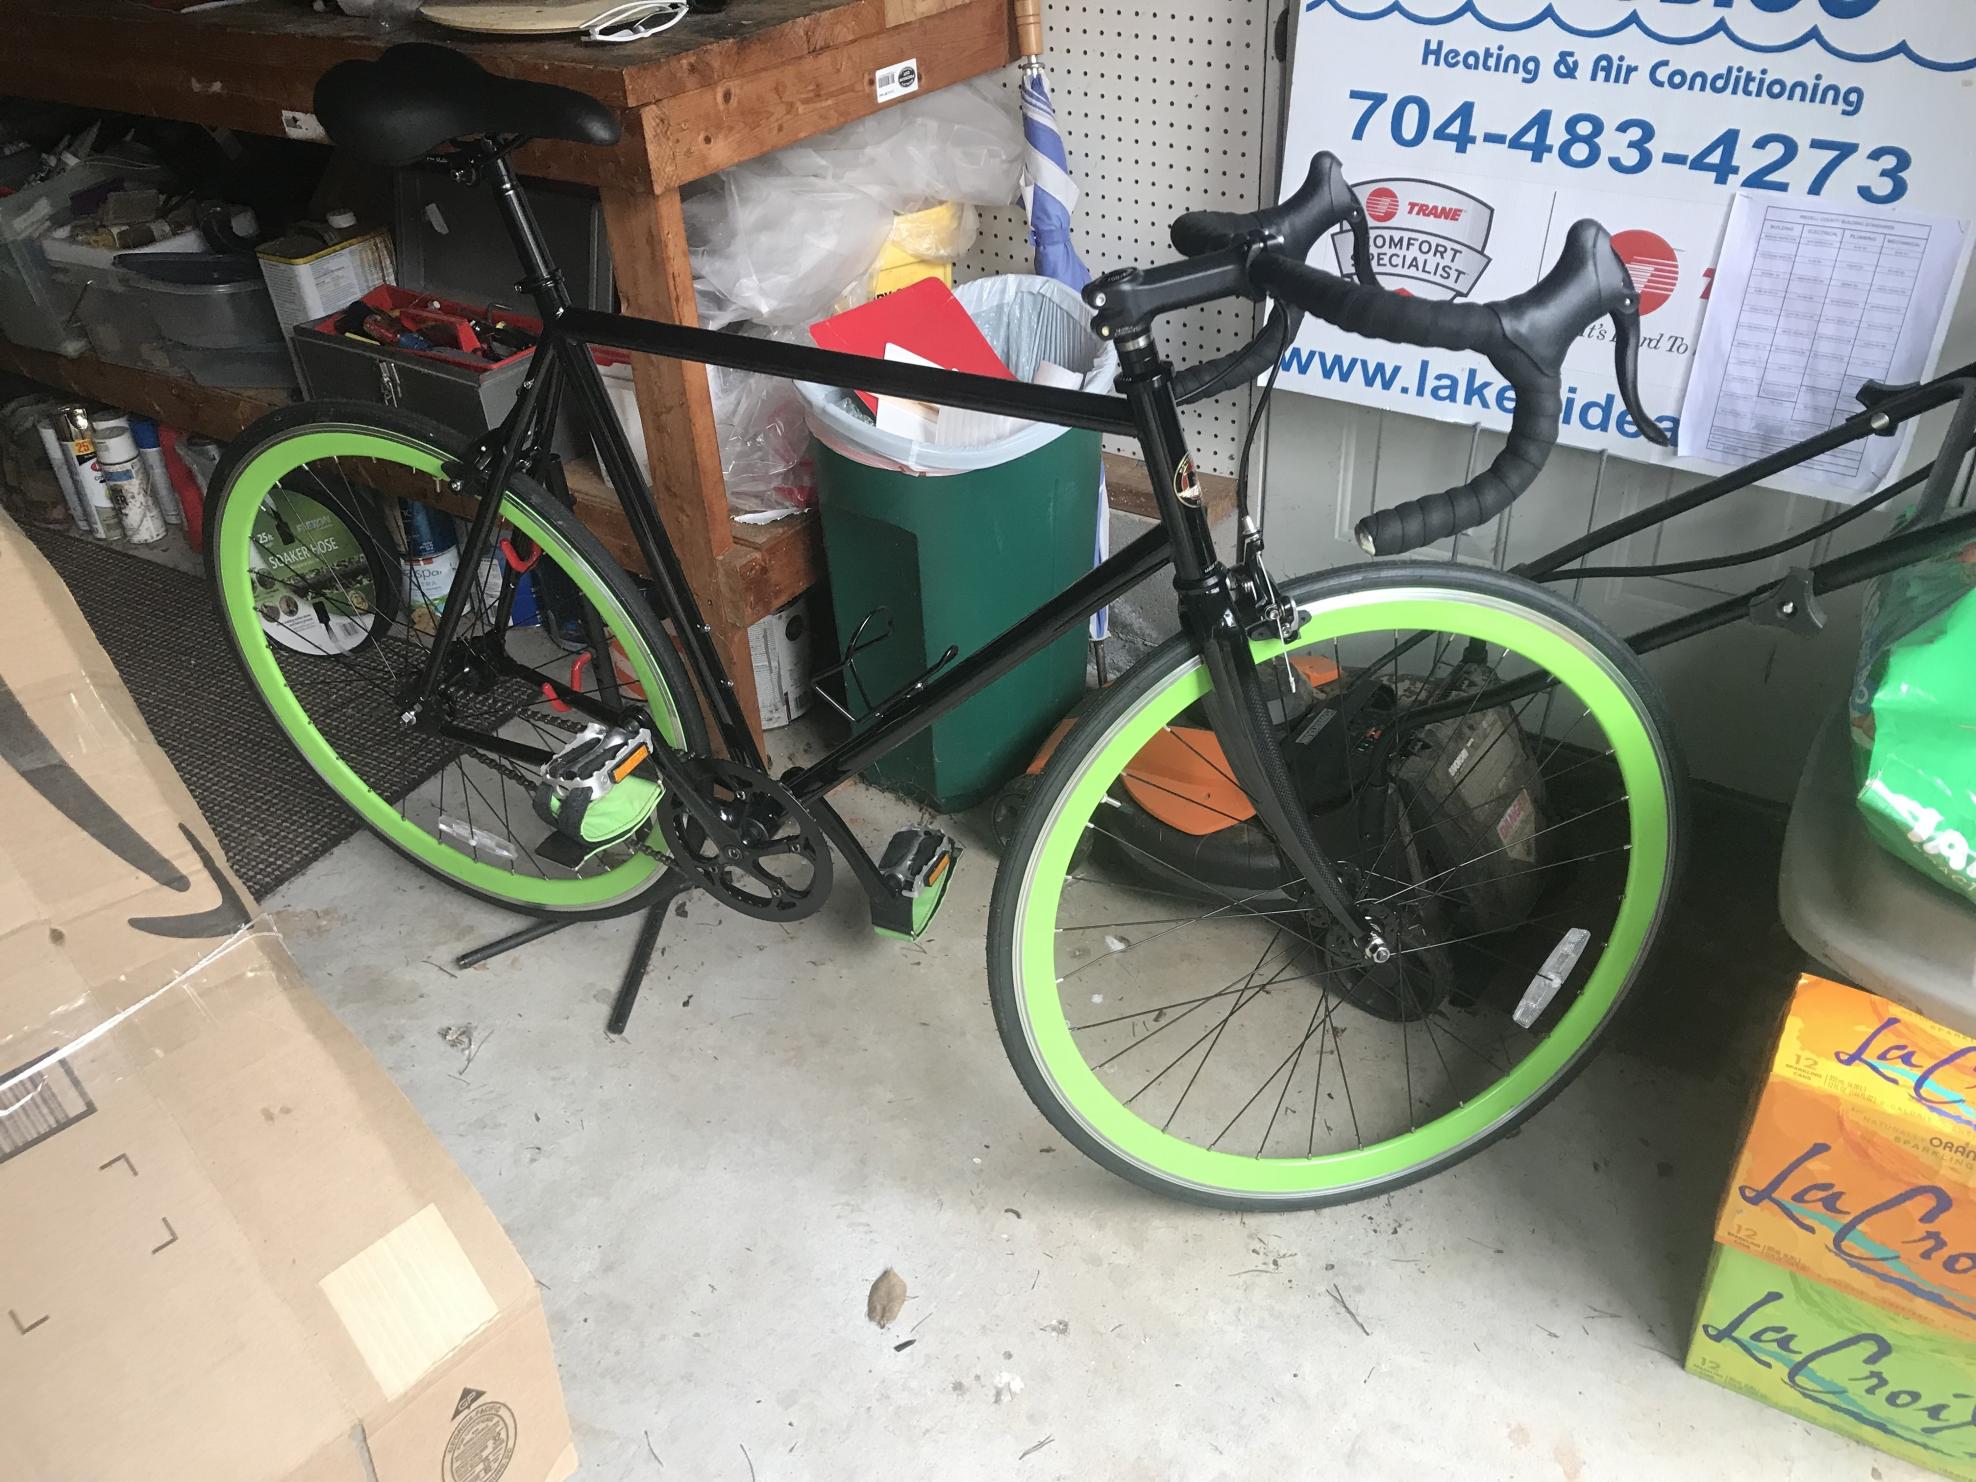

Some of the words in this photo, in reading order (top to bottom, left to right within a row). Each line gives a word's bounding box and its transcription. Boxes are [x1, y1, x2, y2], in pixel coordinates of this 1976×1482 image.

[1421, 39, 1541, 84] Heating
[1553, 50, 1580, 80] &
[1590, 53, 1639, 86] Air
[1649, 59, 1865, 117] Conditioning
[1349, 89, 1913, 206] 704-483-4273
[1407, 201, 1463, 222] TRANE
[1368, 234, 1462, 263] OMFORT
[1579, 322, 1607, 342] t's
[1664, 335, 1689, 355] To
[1280, 346, 1679, 448] www.lakeidea
[268, 545, 311, 570] SOAKER
[311, 536, 339, 557] HOSE
[1793, 1054, 1820, 1071] 12
[1834, 1017, 1923, 1085] La
[1739, 1143, 1850, 1234] La
[1735, 1223, 1758, 1241] 12
[1702, 1291, 1802, 1369] La
[1700, 1356, 1721, 1370] 12
